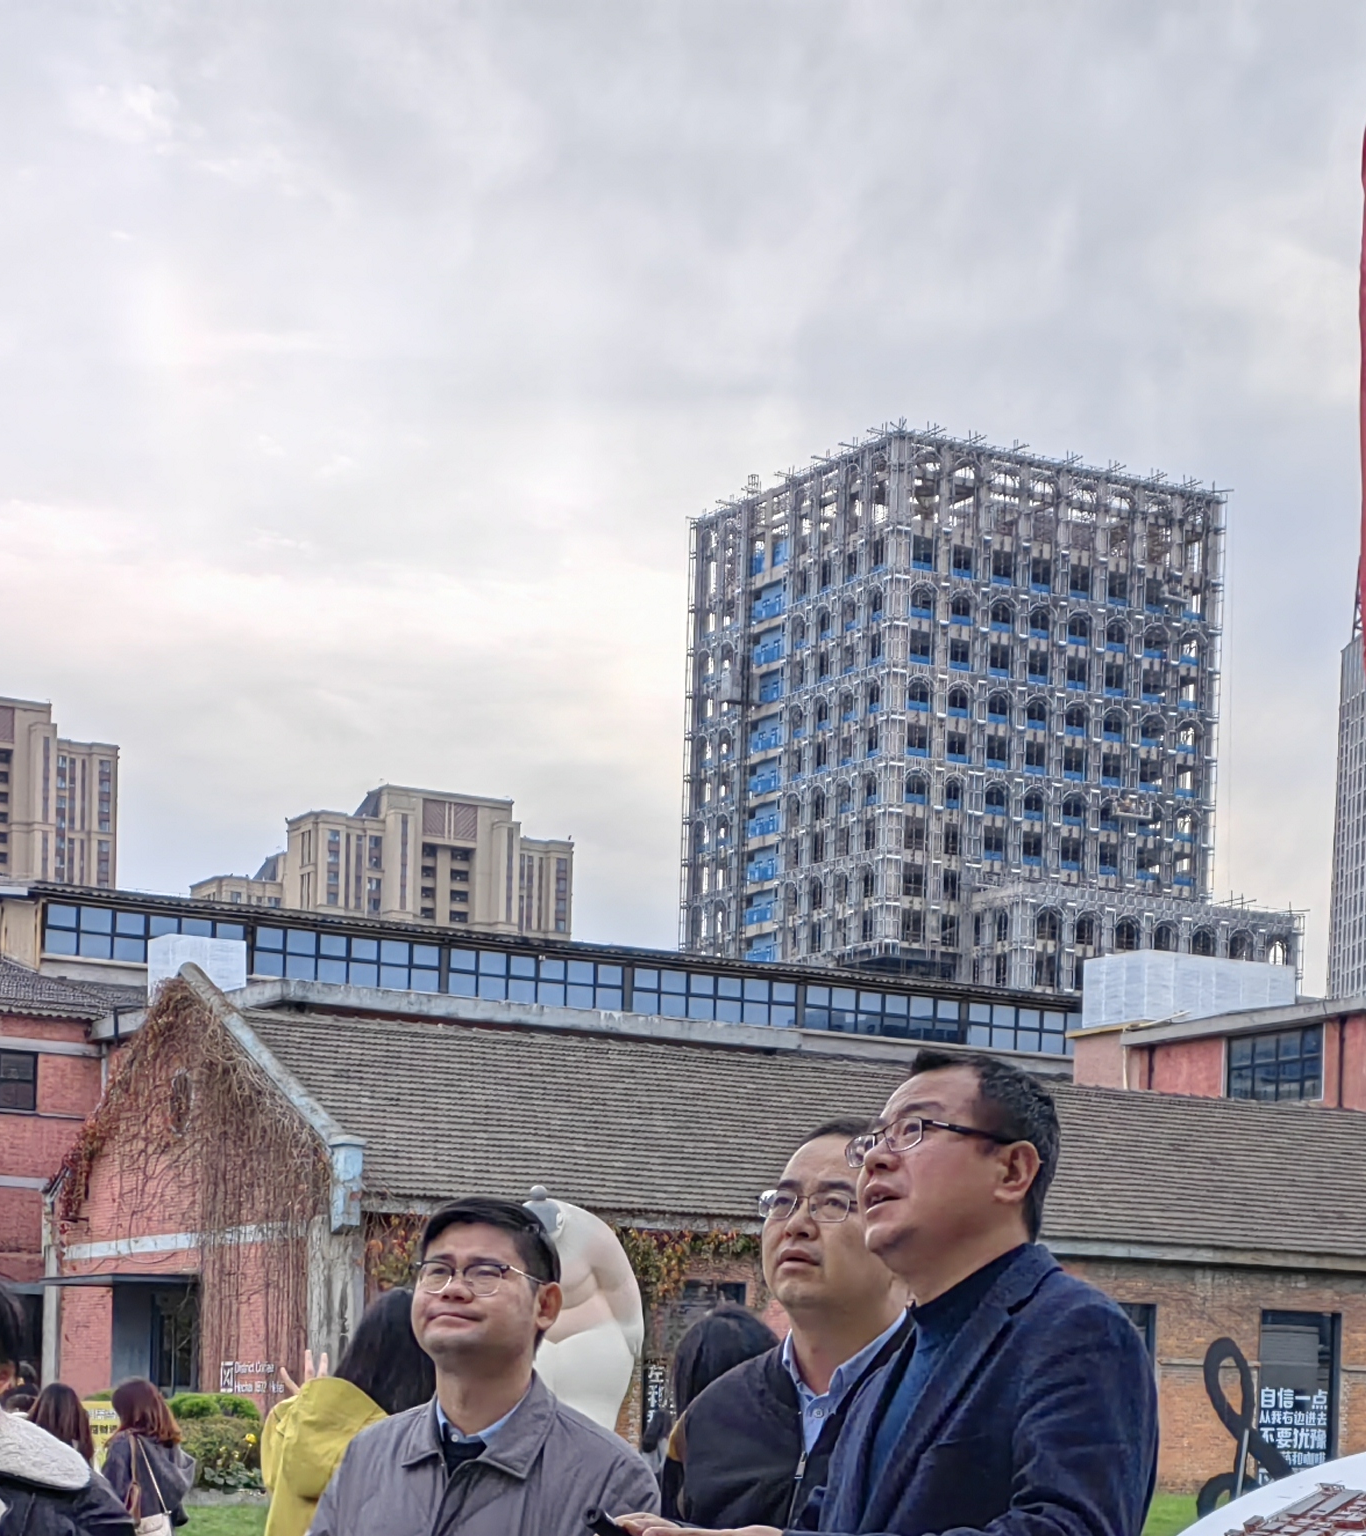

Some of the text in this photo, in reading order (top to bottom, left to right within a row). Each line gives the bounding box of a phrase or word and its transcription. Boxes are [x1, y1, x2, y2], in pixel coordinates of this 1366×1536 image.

[1260, 1386, 1328, 1410] 自信一点
[1259, 1410, 1327, 1426] 从我右边进去
[1260, 1427, 1327, 1449] 不要犹豫
